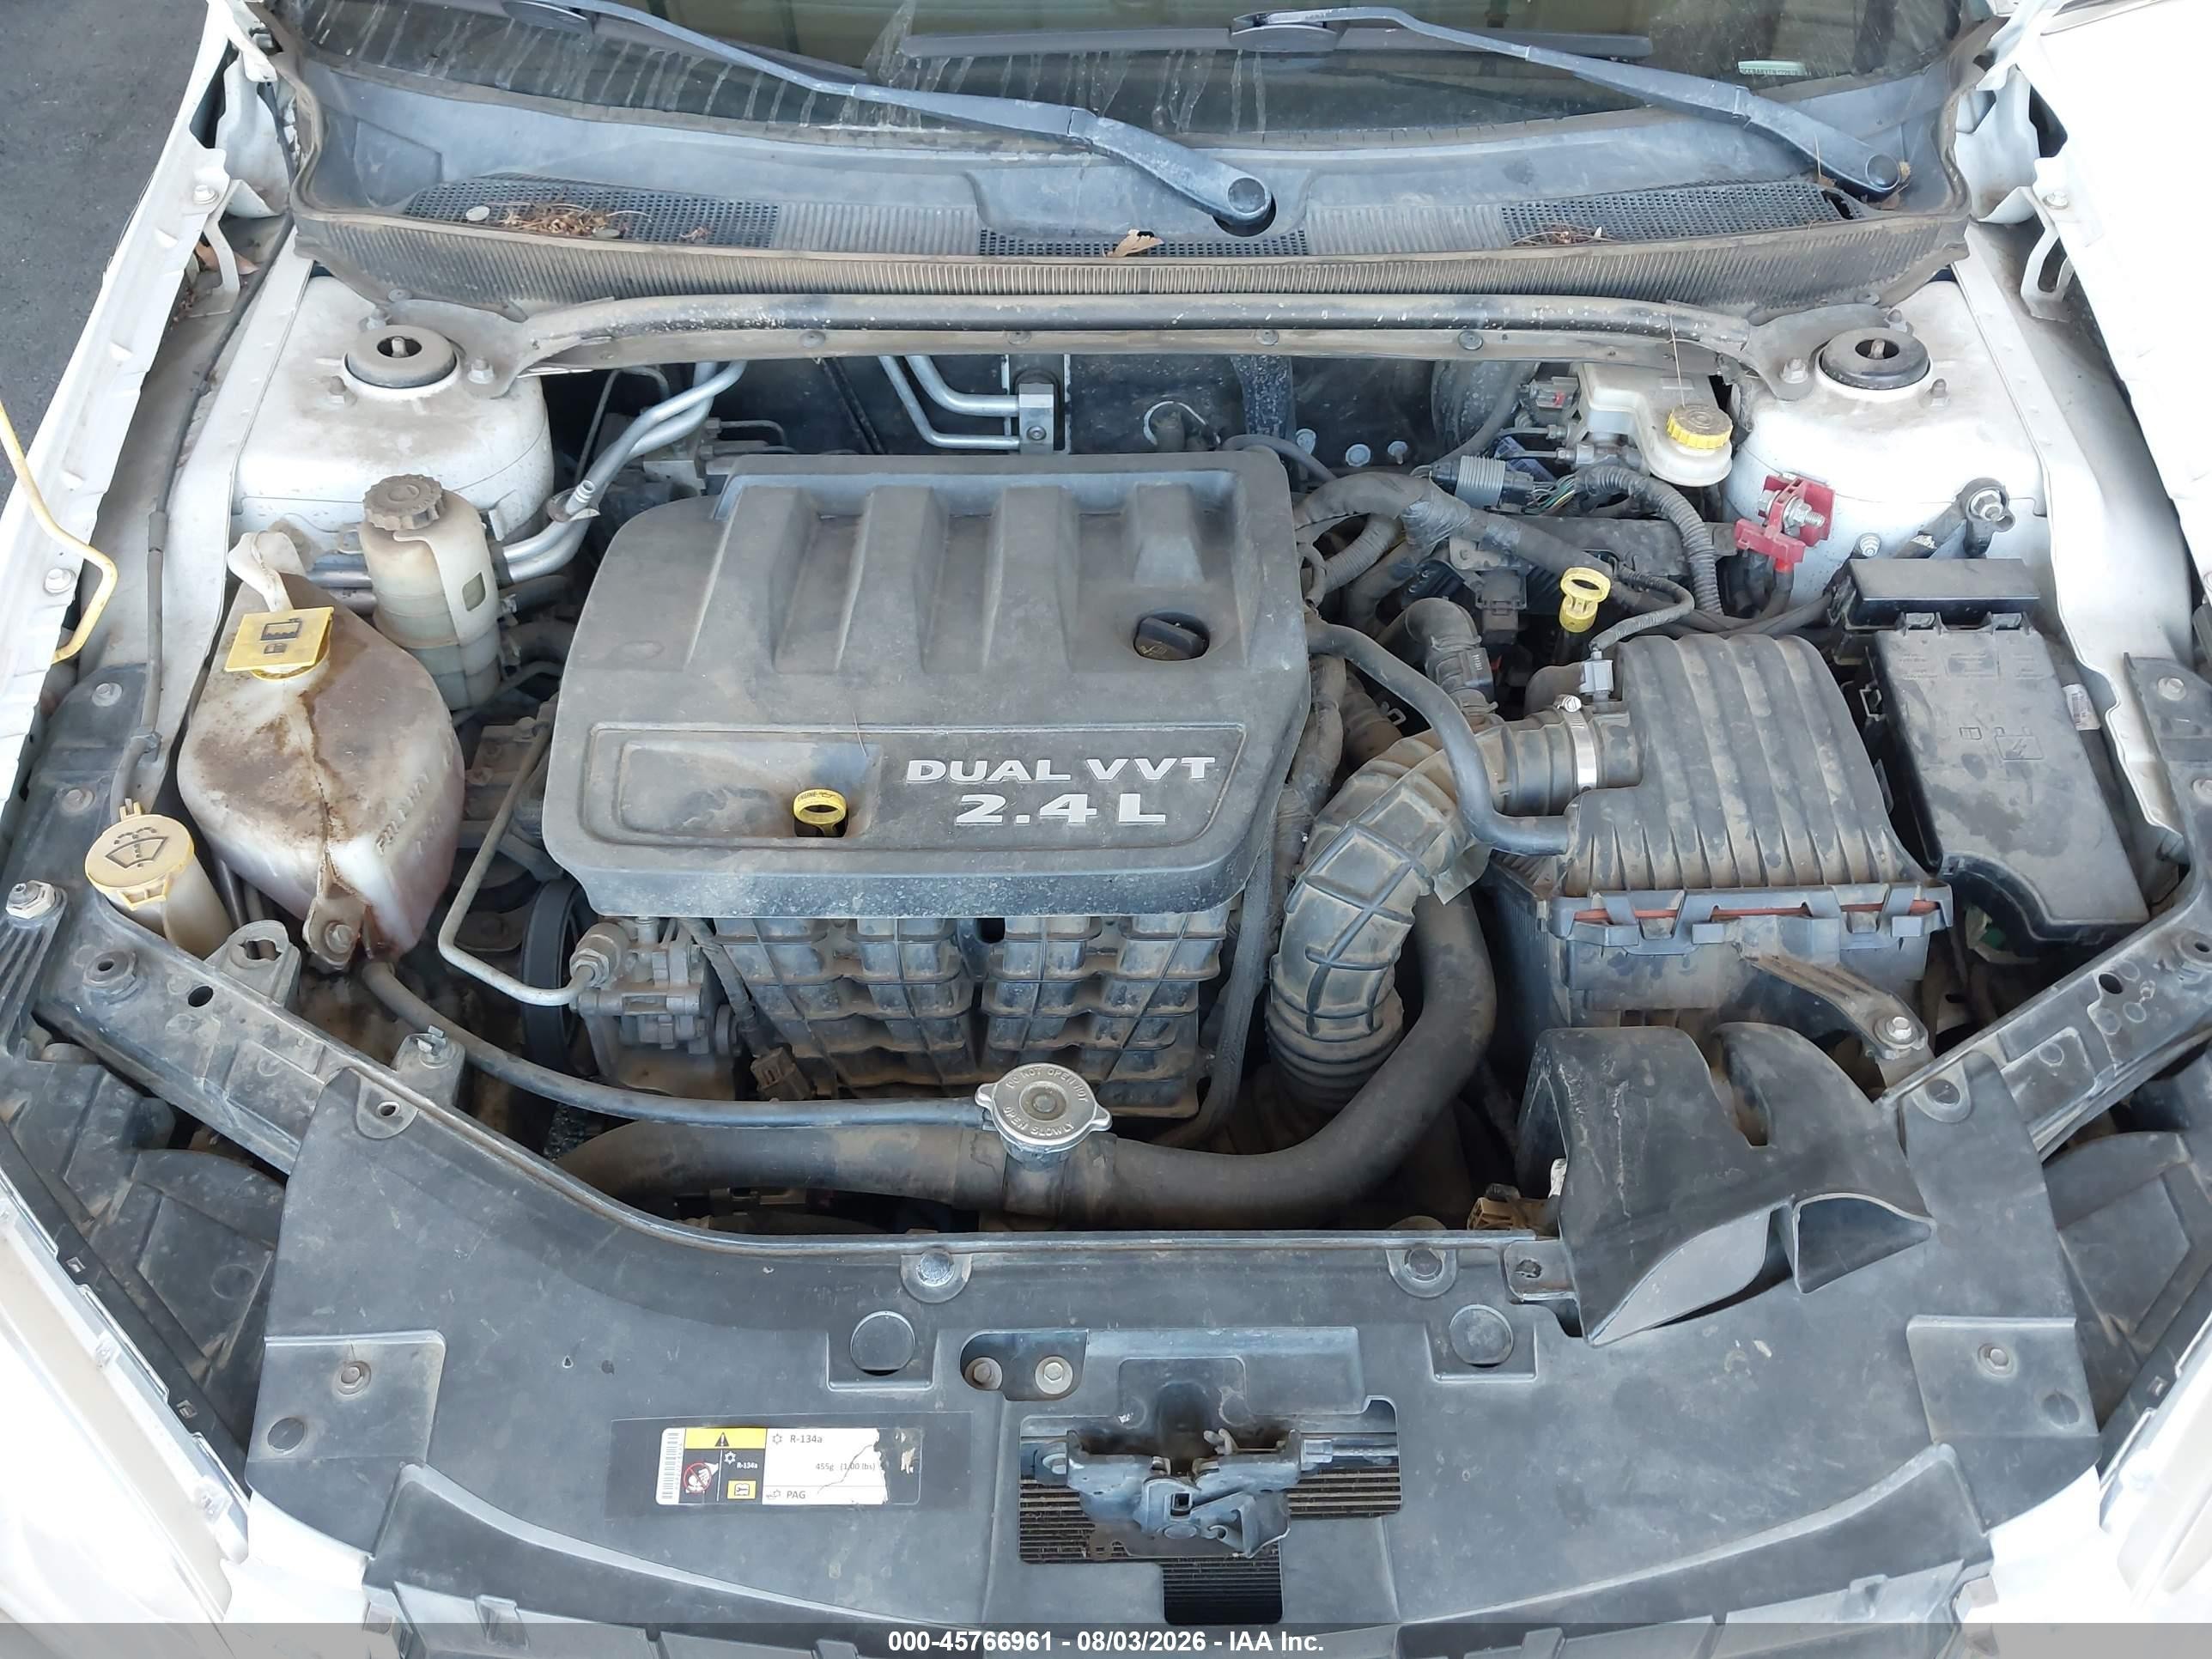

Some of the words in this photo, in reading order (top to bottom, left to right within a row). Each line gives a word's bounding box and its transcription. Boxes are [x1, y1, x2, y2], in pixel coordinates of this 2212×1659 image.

[906, 759, 1071, 784] DUAL
[1085, 757, 1216, 782] VVT
[955, 793, 1098, 826] 2.4
[1117, 792, 1167, 825] L
[1006, 1076, 1019, 1089] DO
[1021, 1066, 1042, 1079] NOT
[1047, 1067, 1077, 1085] OPEN
[1074, 1084, 1088, 1103] HOT
[1003, 1105, 1029, 1130] OPEN
[1030, 1121, 1074, 1137] SLOWLY
[790, 1435, 823, 1443] R-134a
[736, 1462, 758, 1470] R-134a
[816, 1462, 834, 1472] 455g
[862, 1462, 876, 1471] lbs)
[787, 1490, 806, 1499] PAG
